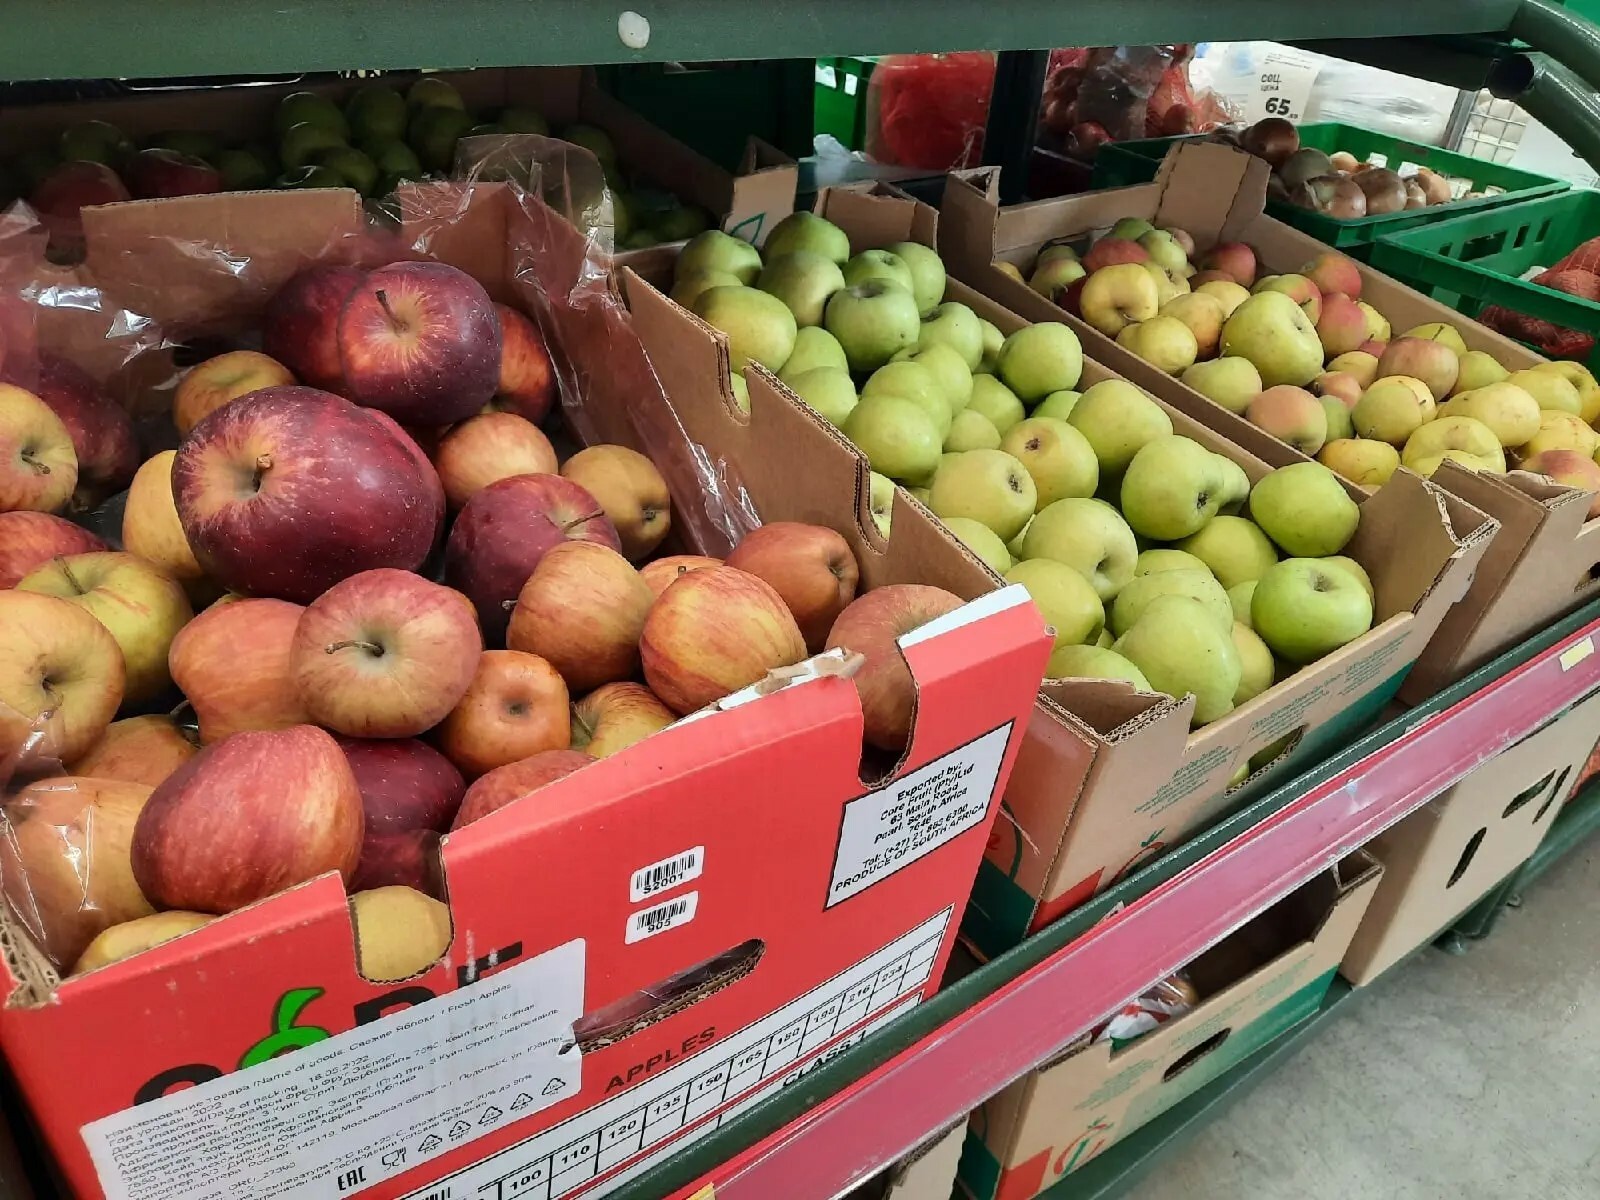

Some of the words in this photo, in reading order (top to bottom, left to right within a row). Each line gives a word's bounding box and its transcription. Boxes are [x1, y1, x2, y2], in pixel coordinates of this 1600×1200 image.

[1266, 97, 1290, 116] 65
[897, 770, 944, 802] Exported
[906, 800, 930, 818] Main
[933, 782, 958, 802] Road
[908, 788, 932, 806] Fruit
[906, 805, 937, 826] South
[938, 787, 968, 809] Africa
[834, 855, 892, 892] PRODUCE
[894, 845, 912, 860] OF
[911, 826, 947, 851] SOUTH
[948, 802, 985, 830] AFRICA
[643, 872, 684, 894] S2001
[604, 1026, 716, 1094] APPLES
[782, 1040, 850, 1087] CLASS
[510, 1170, 542, 1190] 100
[560, 1145, 590, 1164] 110
[608, 1120, 637, 1139] 120
[653, 1096, 681, 1115] 135
[698, 1072, 723, 1091] 150
[737, 1050, 763, 1068] 165
[338, 1165, 366, 1191] EAC
